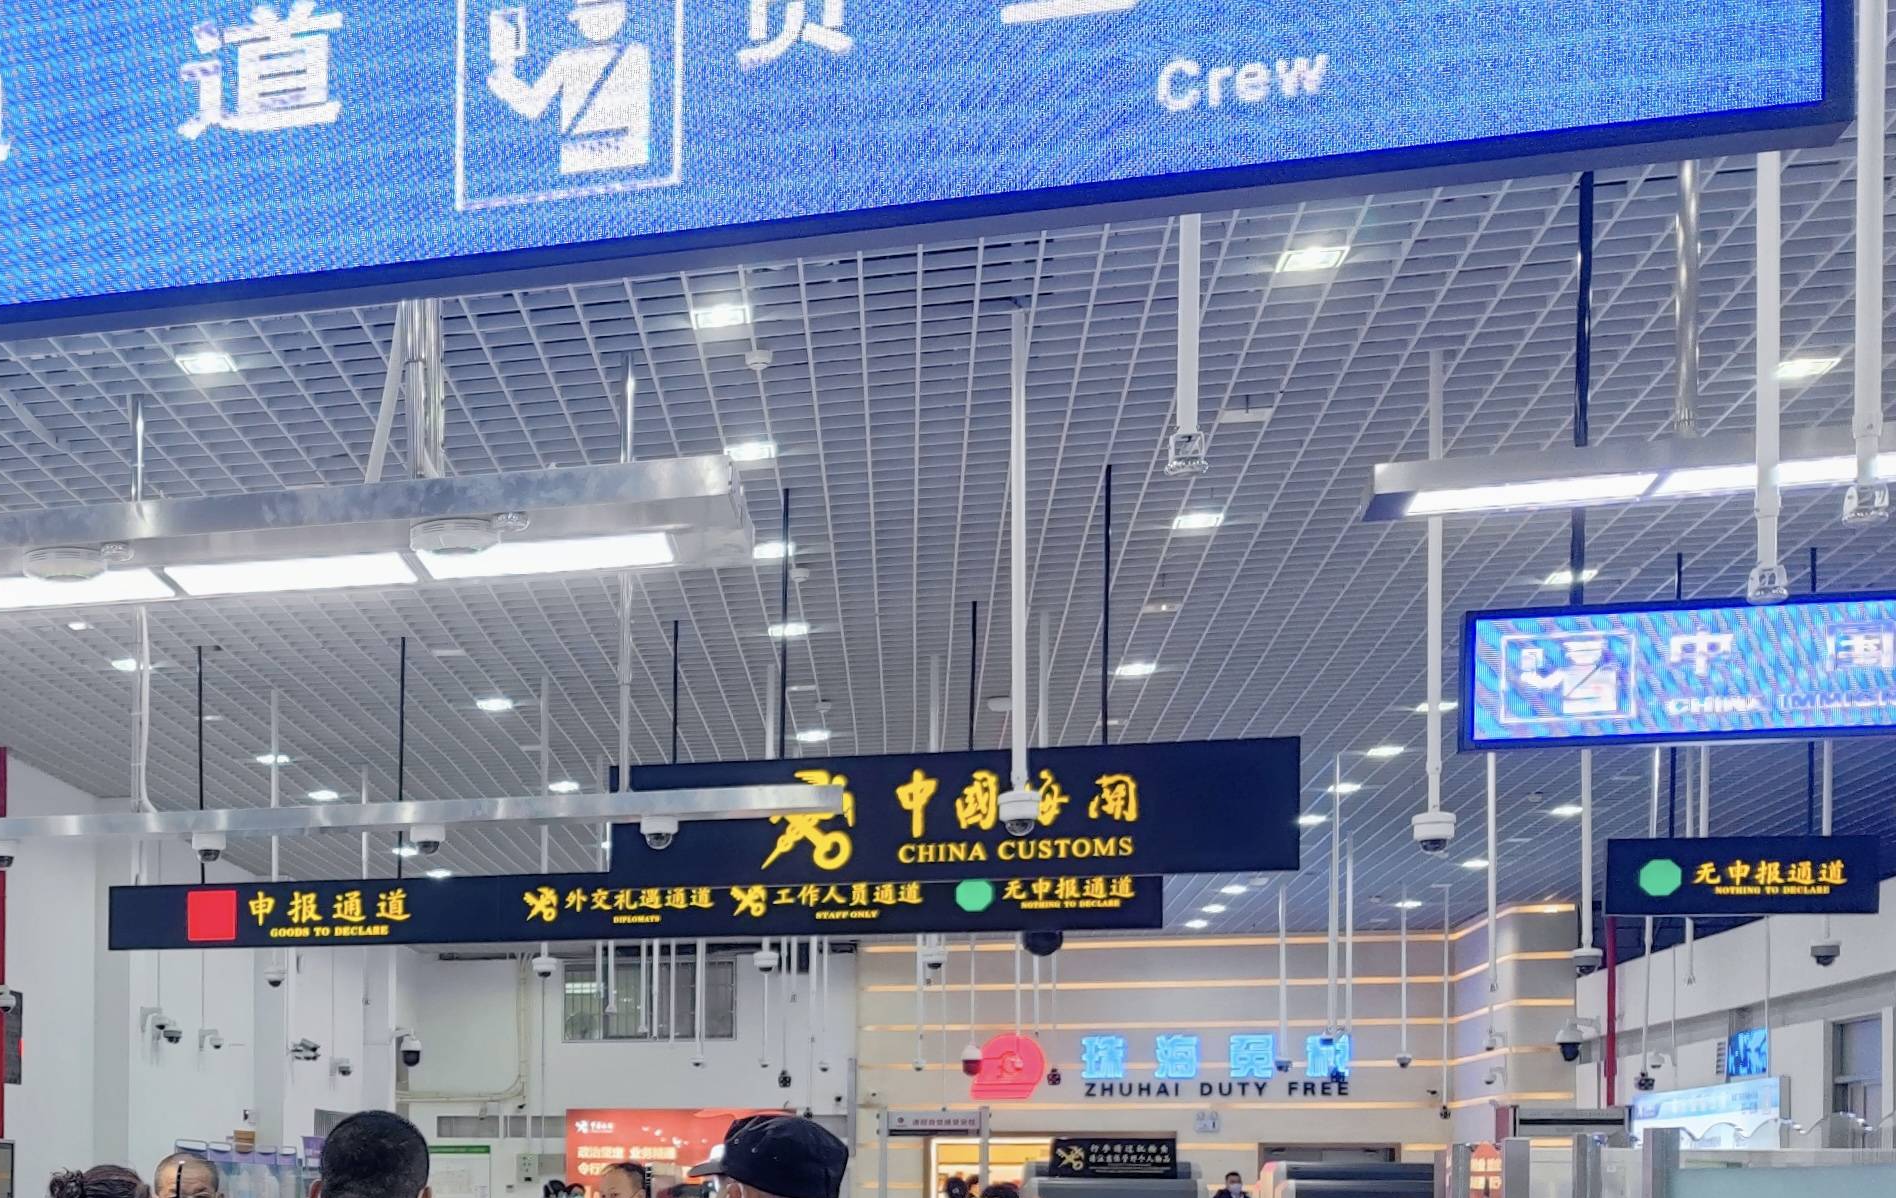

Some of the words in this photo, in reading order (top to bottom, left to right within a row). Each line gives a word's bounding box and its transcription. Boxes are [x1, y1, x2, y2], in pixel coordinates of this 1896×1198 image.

[1156, 47, 1329, 113] Crew
[898, 840, 986, 863] CHINA
[997, 836, 1134, 860] CUSTOMS
[1692, 859, 1848, 885] 无申报通道
[565, 887, 715, 913] 外交礼遇通道
[773, 881, 923, 906] 工作人员通道
[1002, 875, 1136, 901] 无申报通道
[1715, 885, 1761, 894] NOTHING
[1765, 885, 1779, 894] TO
[1783, 885, 1831, 894] DECLARE
[248, 888, 411, 926] 申报通道
[815, 910, 849, 921] STAFF
[850, 909, 879, 920] ONLY
[1021, 900, 1061, 909] NOTHING
[1064, 899, 1077, 908] TO
[1078, 899, 1121, 908] DECLARE
[270, 927, 310, 937] GOODS
[314, 926, 330, 937] TO
[334, 925, 390, 937] DECLARE
[1084, 1082, 1179, 1097] ZHUHAI
[1200, 1082, 1268, 1097] DUTY
[1288, 1081, 1350, 1096] FREE
